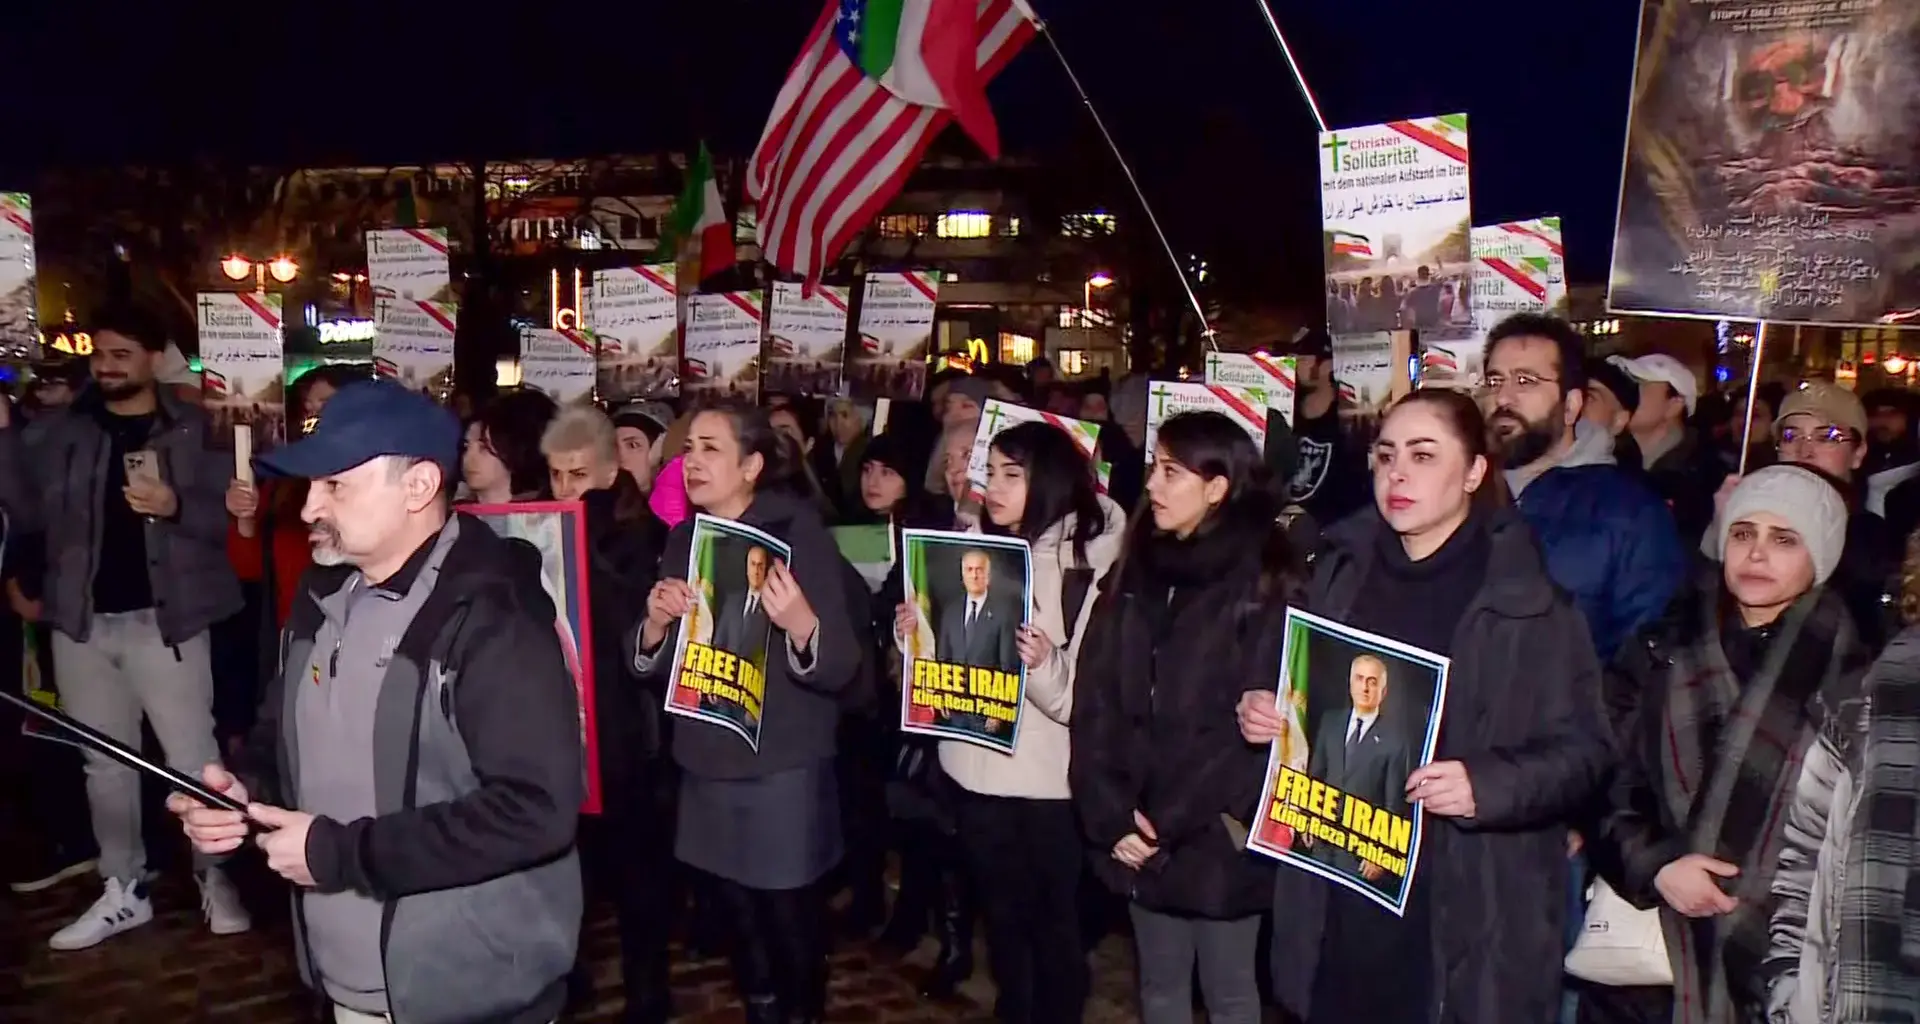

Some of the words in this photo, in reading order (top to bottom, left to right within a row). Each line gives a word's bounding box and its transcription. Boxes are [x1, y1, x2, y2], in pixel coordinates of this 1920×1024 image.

[1350, 136, 1401, 151] Christen
[1342, 146, 1419, 172] Solidarität
[1356, 172, 1397, 188] nationalen
[1399, 167, 1434, 182] Aufstand
[685, 642, 737, 682] FREE
[680, 670, 712, 695] King
[914, 659, 965, 694] FREE
[969, 666, 1020, 704] IRAN
[912, 688, 942, 712] King
[944, 692, 975, 713] Reza
[1276, 766, 1340, 822] FREE
[1342, 794, 1412, 855] IRAN
[1269, 799, 1308, 833] King
[1310, 816, 1346, 848] Reza
[1347, 832, 1408, 878] Pahlavi
